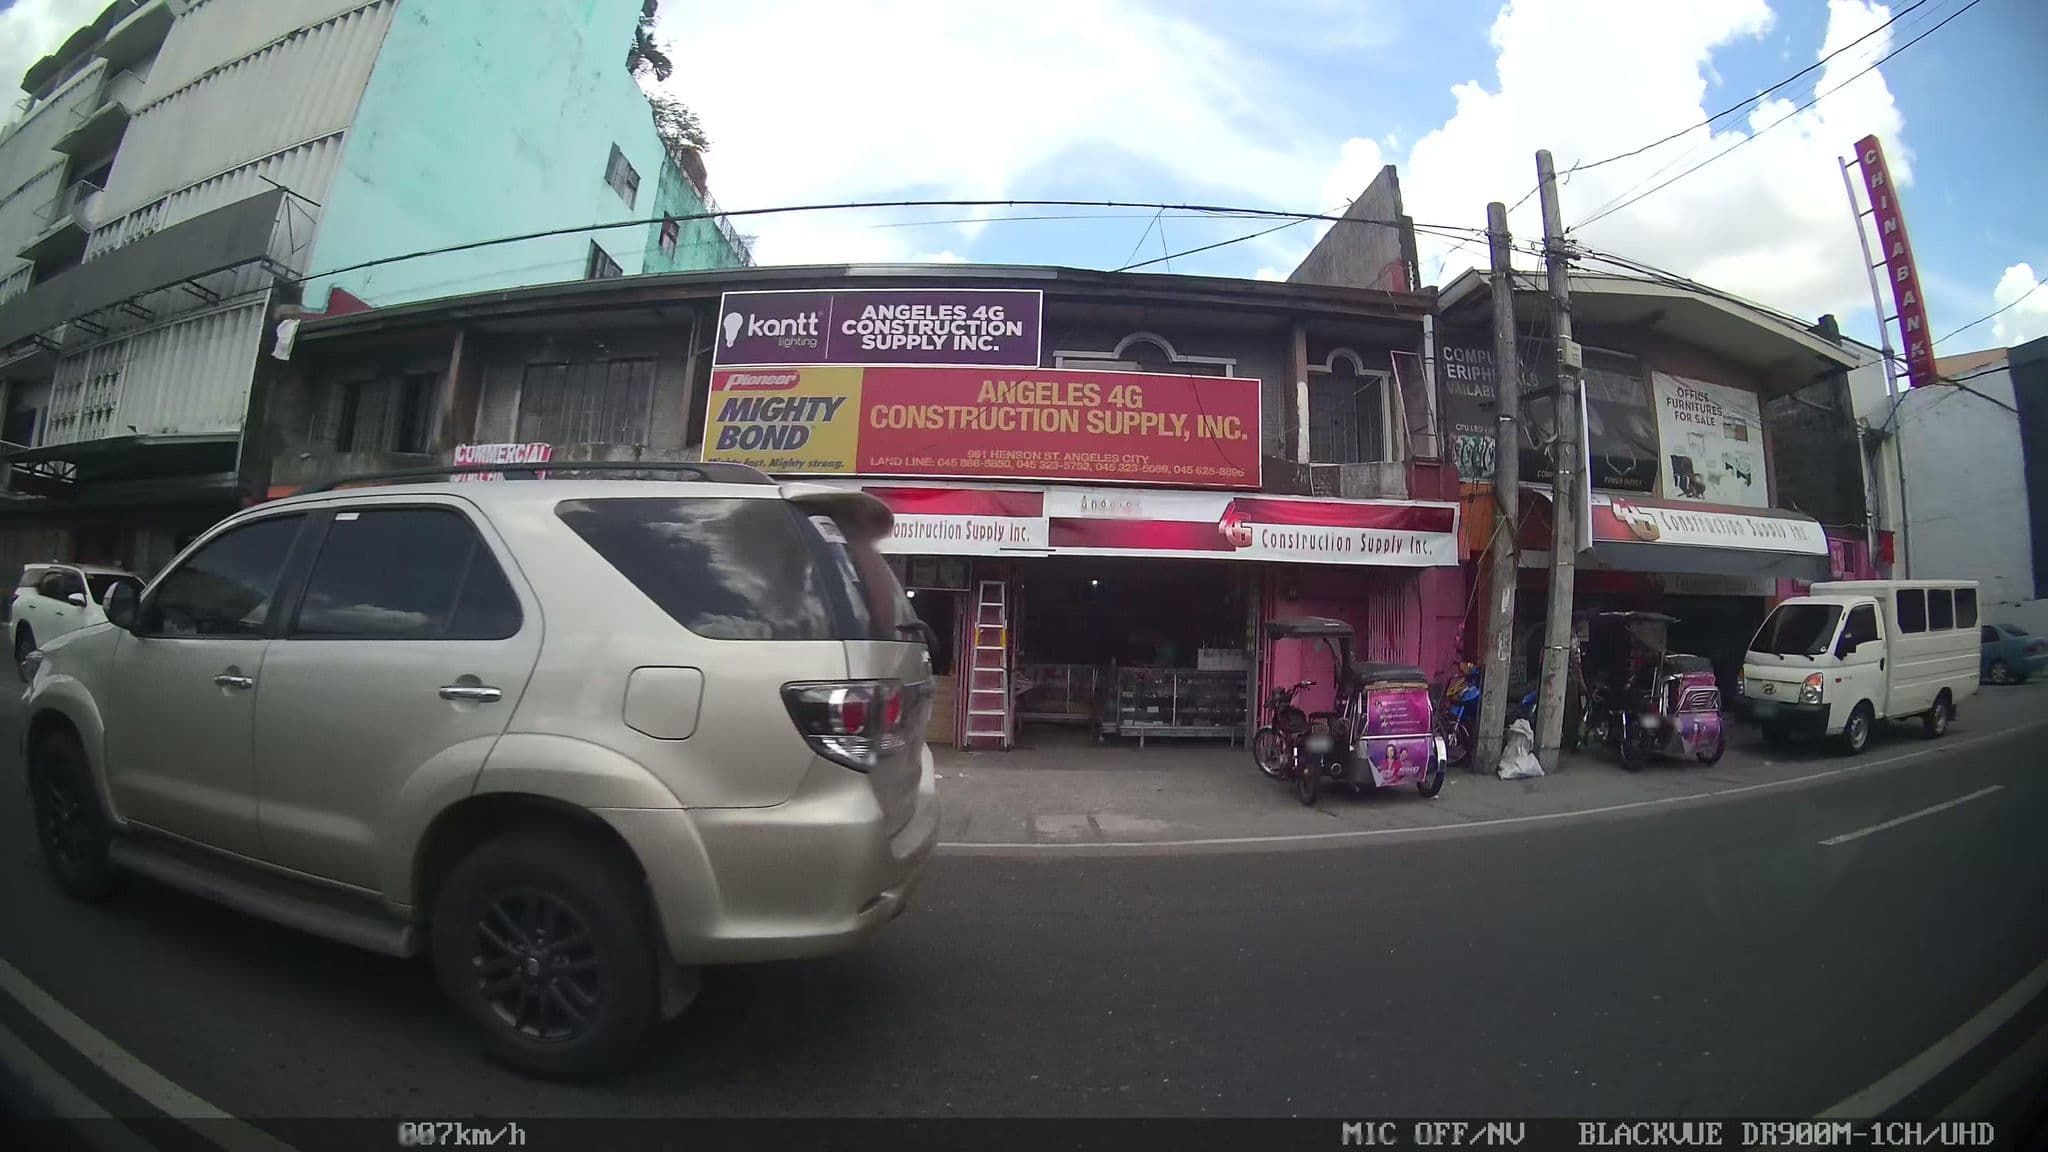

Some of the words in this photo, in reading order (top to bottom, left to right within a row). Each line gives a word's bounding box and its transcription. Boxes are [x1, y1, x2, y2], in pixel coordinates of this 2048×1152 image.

[1864, 150, 1926, 359] CHINABANK
[861, 305, 967, 320] ANGELES
[973, 305, 1005, 321] 4G
[747, 312, 818, 337] kantt
[841, 319, 1023, 336] CONSTRUCTION
[778, 337, 818, 348] lighting
[861, 335, 948, 350] SUPPLY
[953, 336, 1000, 351] INC.
[723, 373, 798, 391] Pioneer
[977, 379, 1101, 407] ANGELES
[1107, 384, 1143, 409] 4G
[1676, 387, 1710, 403] OFFICE
[716, 396, 847, 422] MIGHTY
[1666, 397, 1723, 417] FURNITURES
[869, 404, 1079, 433] CONSTRUCTION
[1086, 411, 1191, 442] SUPPLY,
[1196, 414, 1249, 441] INC.
[1675, 411, 1692, 423] FOR
[1695, 415, 1716, 426] SALE
[715, 425, 810, 451] BOND
[456, 444, 547, 464] COMMERCIAL
[769, 458, 806, 469] Mighty
[807, 460, 845, 469] strong.
[990, 450, 1041, 460] HENSON
[1063, 453, 1119, 463] ANGELES
[870, 456, 902, 466] LAND
[1016, 460, 1036, 469] 045
[1095, 463, 1115, 472] 045
[1173, 465, 1193, 475] 045
[893, 520, 962, 540] onstruction
[966, 521, 1004, 542] Supply
[1009, 523, 1030, 542] Inc.
[1661, 511, 1745, 537] Construction
[1747, 518, 1786, 539] Supply
[1262, 529, 1352, 553] Construction
[1360, 533, 1402, 555] Supply
[1410, 535, 1433, 556] Inc.
